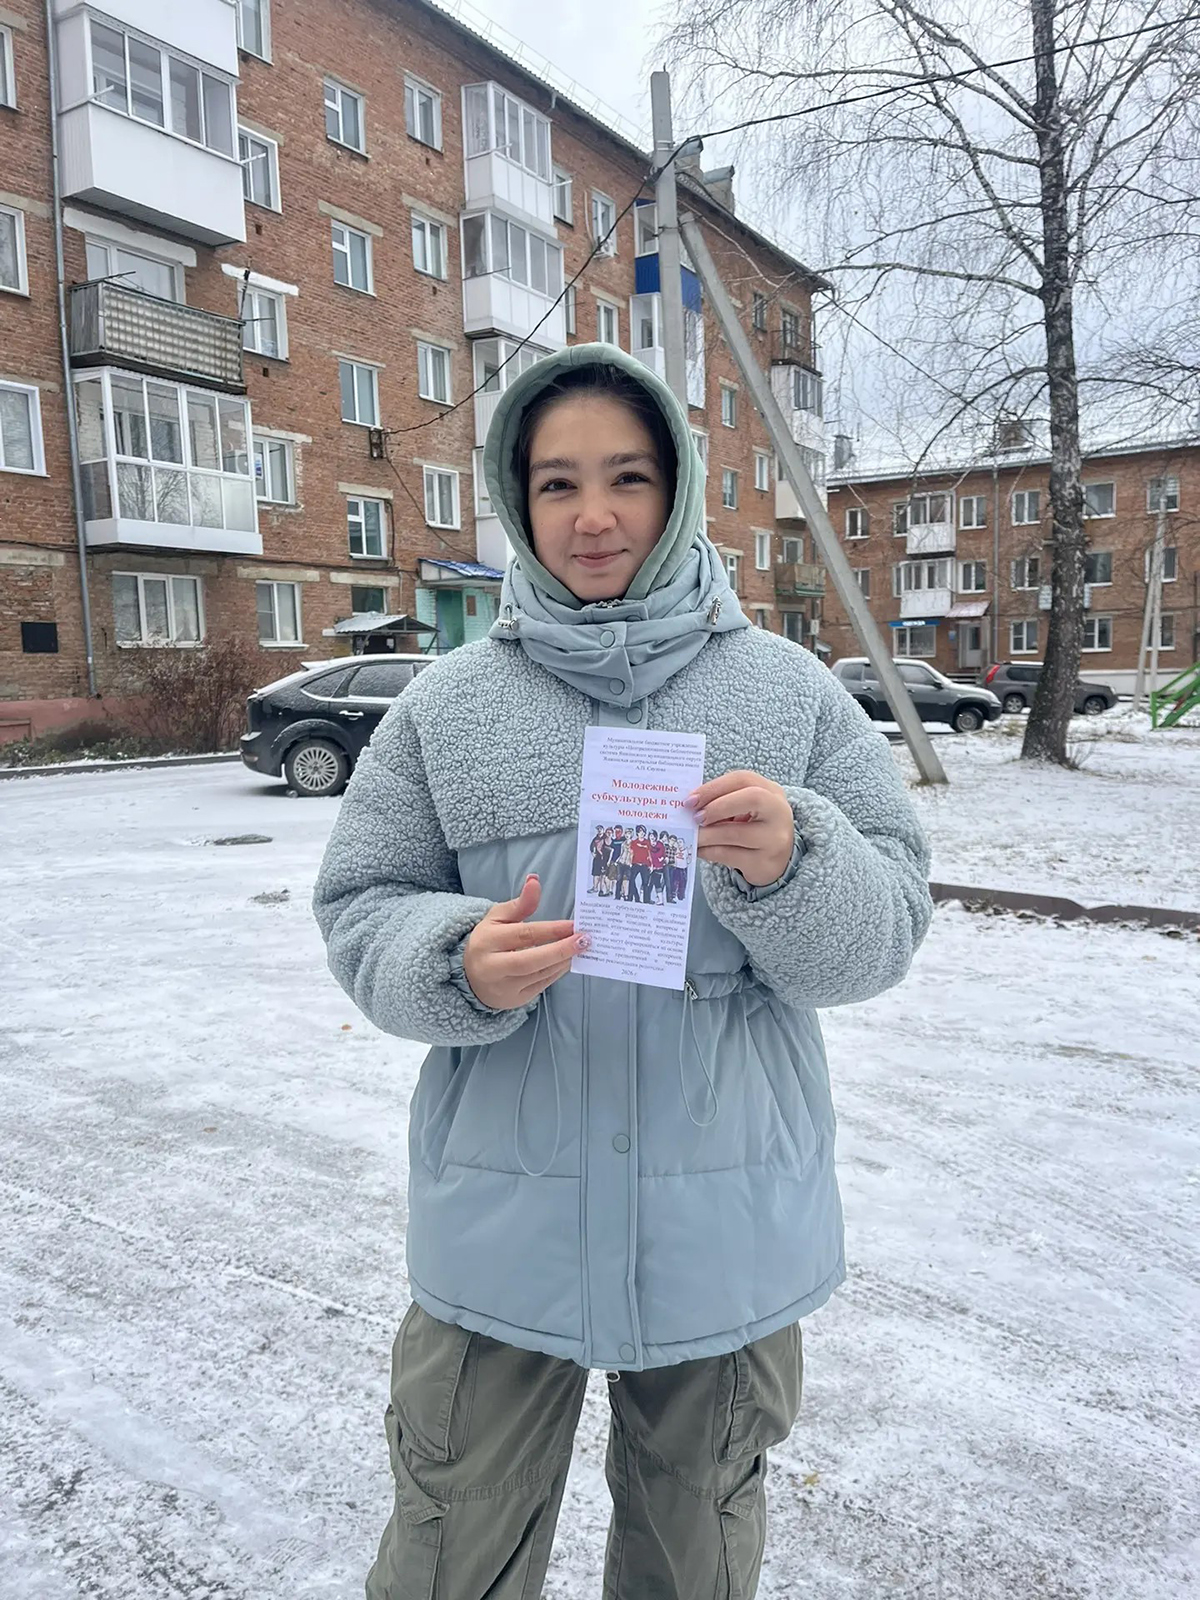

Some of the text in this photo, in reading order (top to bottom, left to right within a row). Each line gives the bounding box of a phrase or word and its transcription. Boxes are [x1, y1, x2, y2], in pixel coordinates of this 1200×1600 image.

[612, 779, 679, 793] Молодежные
[592, 792, 657, 806] субкультуры
[661, 798, 667, 806] в
[618, 808, 668, 820] молодежи
